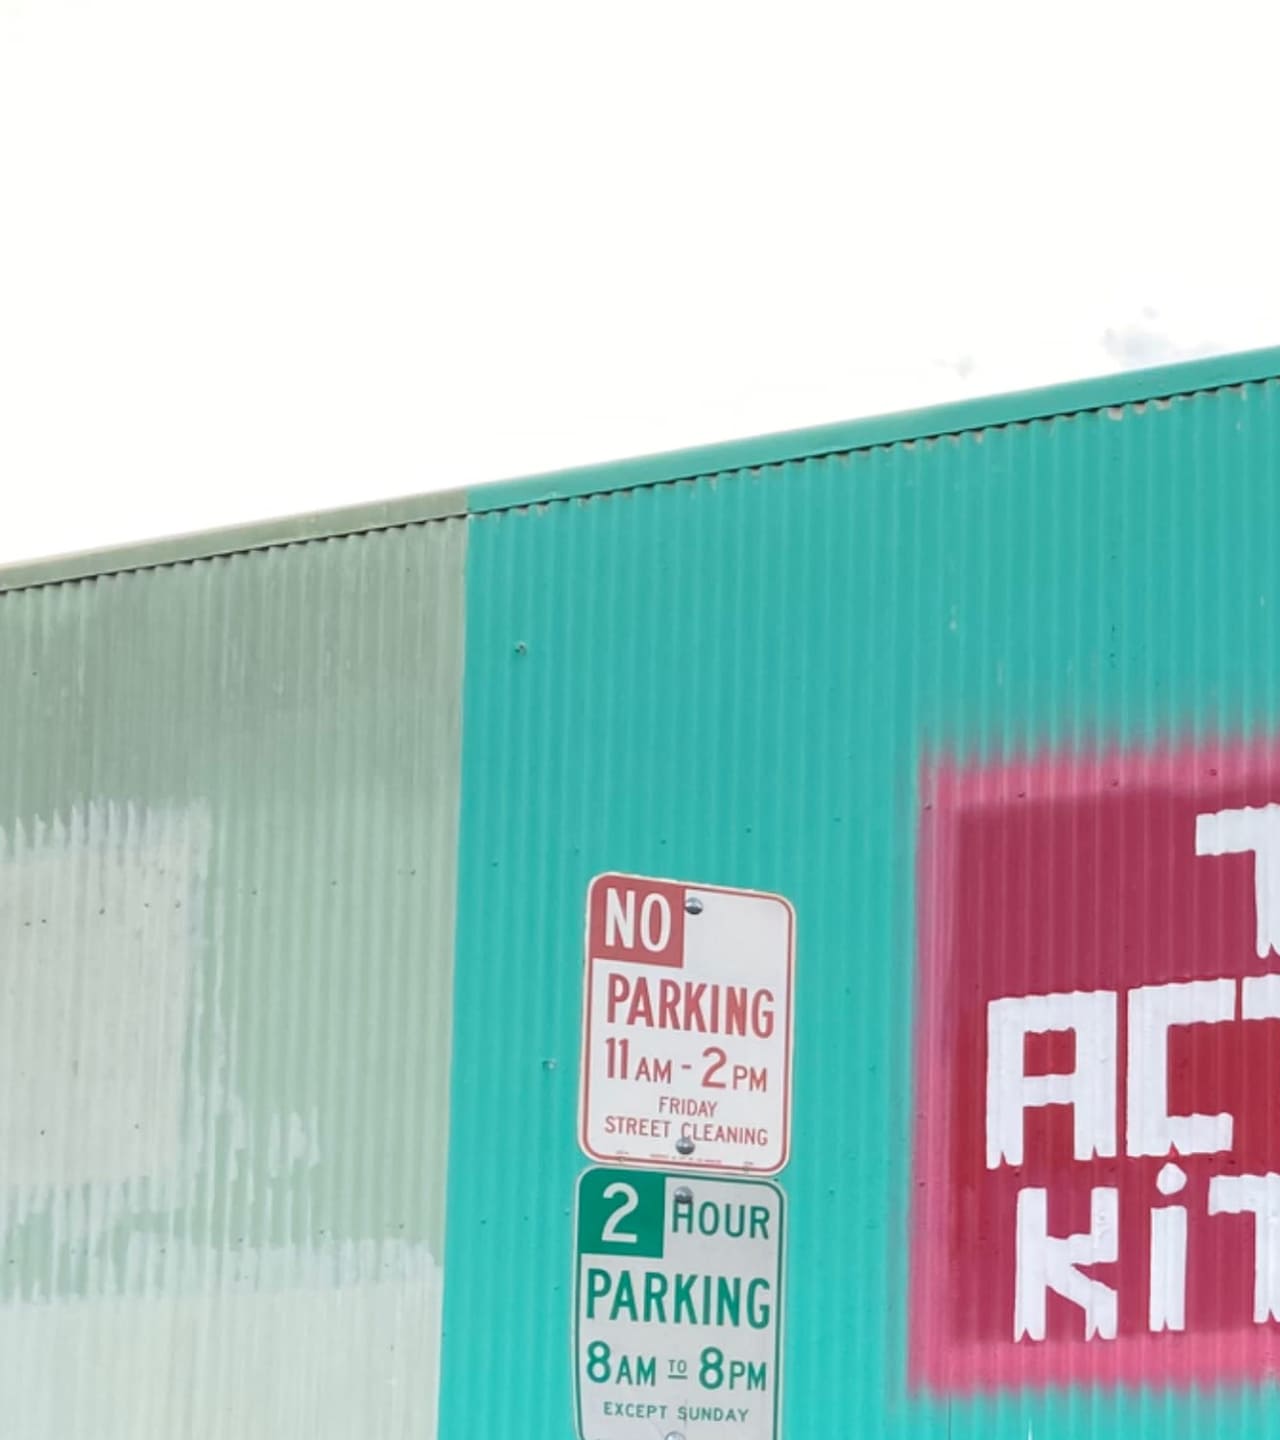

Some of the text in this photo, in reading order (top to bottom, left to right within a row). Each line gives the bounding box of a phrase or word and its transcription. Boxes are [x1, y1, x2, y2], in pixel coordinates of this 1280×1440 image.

[604, 887, 671, 953] NO
[605, 972, 775, 1038] PARKING
[701, 1047, 768, 1092] 2PM
[605, 1116, 769, 1146] STREET CLEANING
[658, 1096, 717, 1118] FRIDAY
[600, 1182, 771, 1244] 2 HOUR
[586, 1268, 771, 1330] PARKING
[586, 1340, 767, 1393] 8AM TO 8PM
[603, 1401, 749, 1424] EXCEPT SUNDAY
